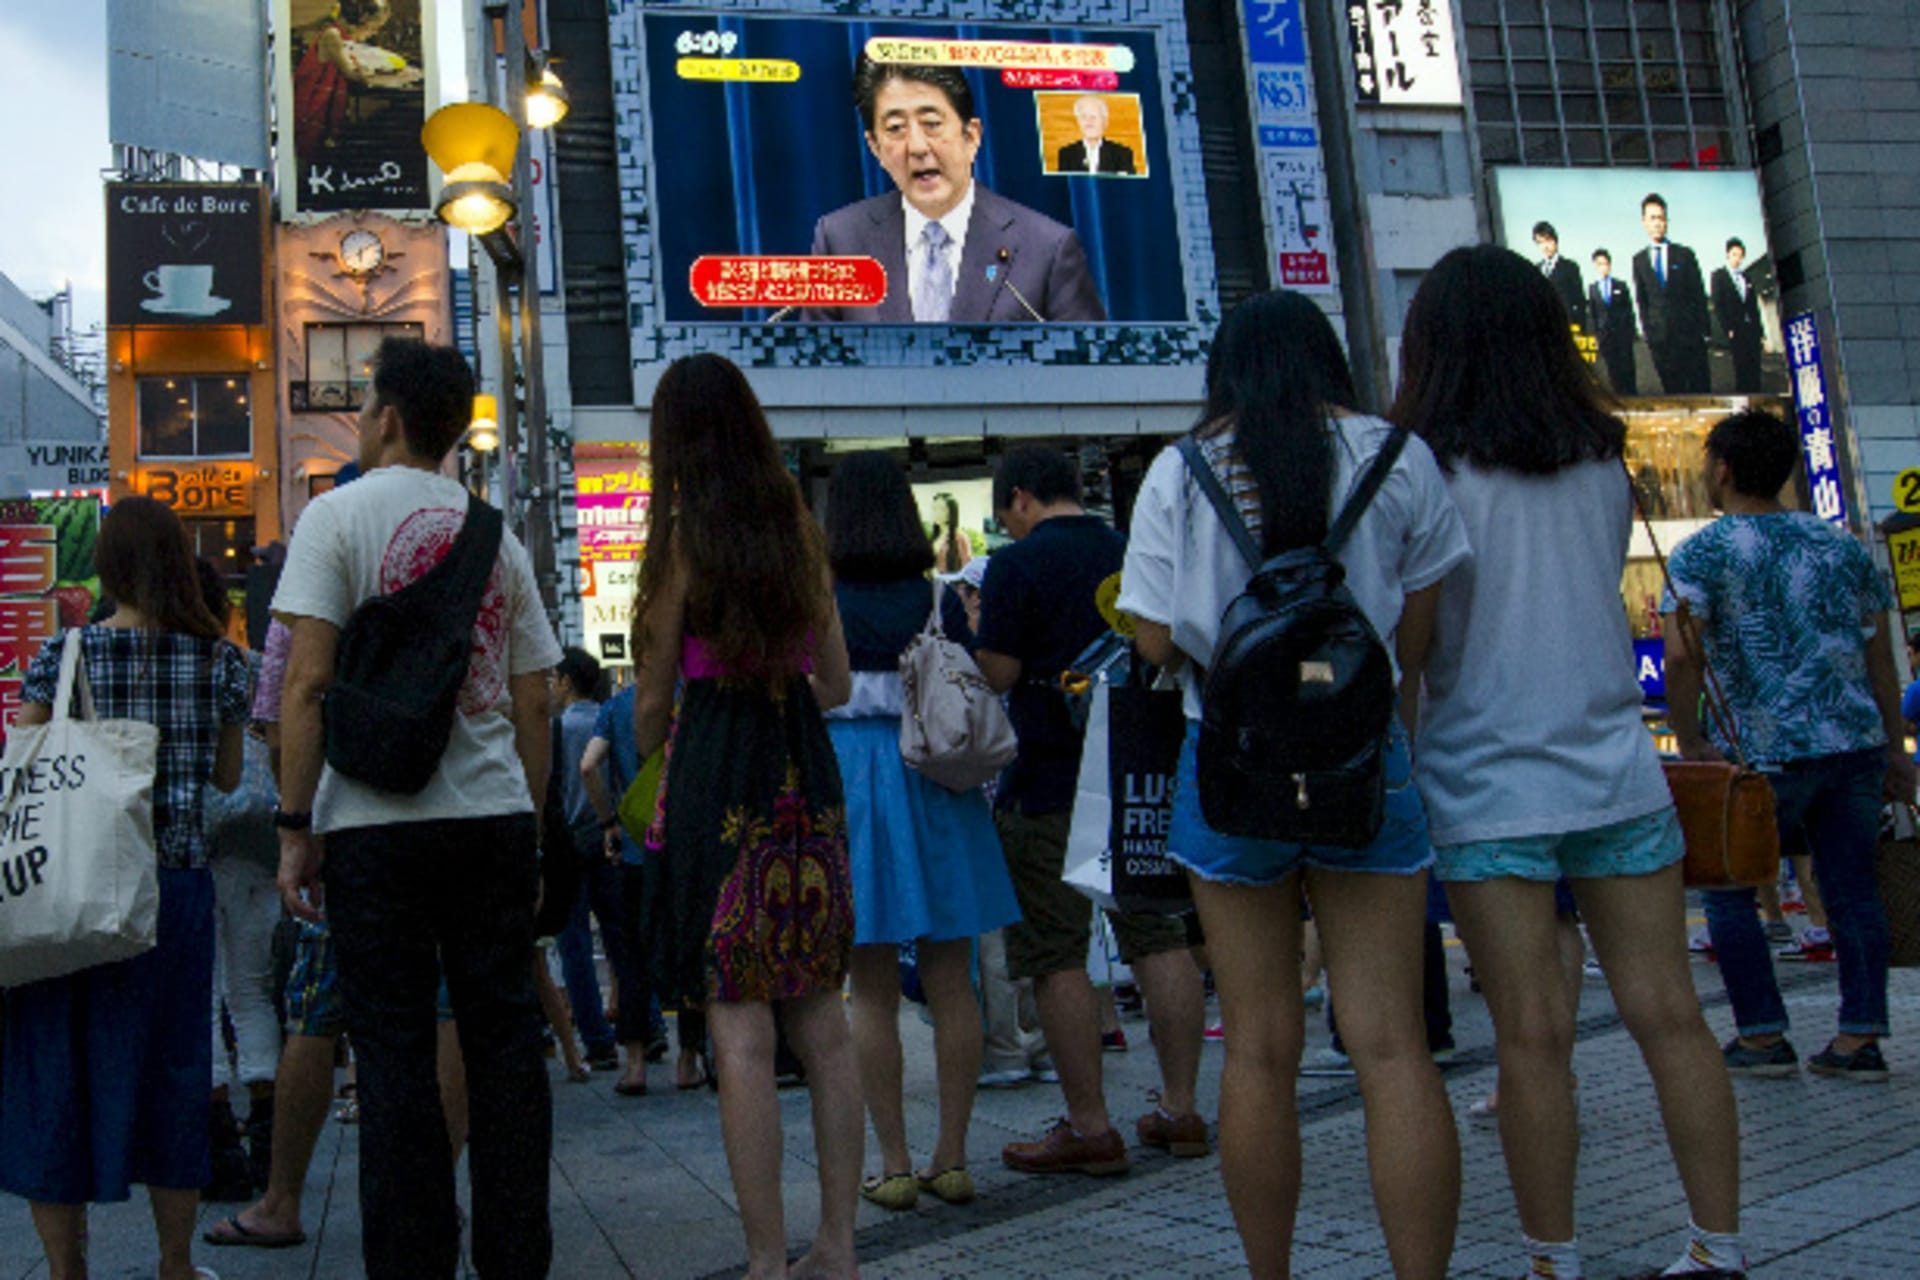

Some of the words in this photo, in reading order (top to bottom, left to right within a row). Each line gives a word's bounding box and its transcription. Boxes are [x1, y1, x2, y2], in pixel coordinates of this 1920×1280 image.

[675, 30, 738, 54] 6:09
[173, 196, 197, 214] de
[202, 196, 250, 214] Bore
